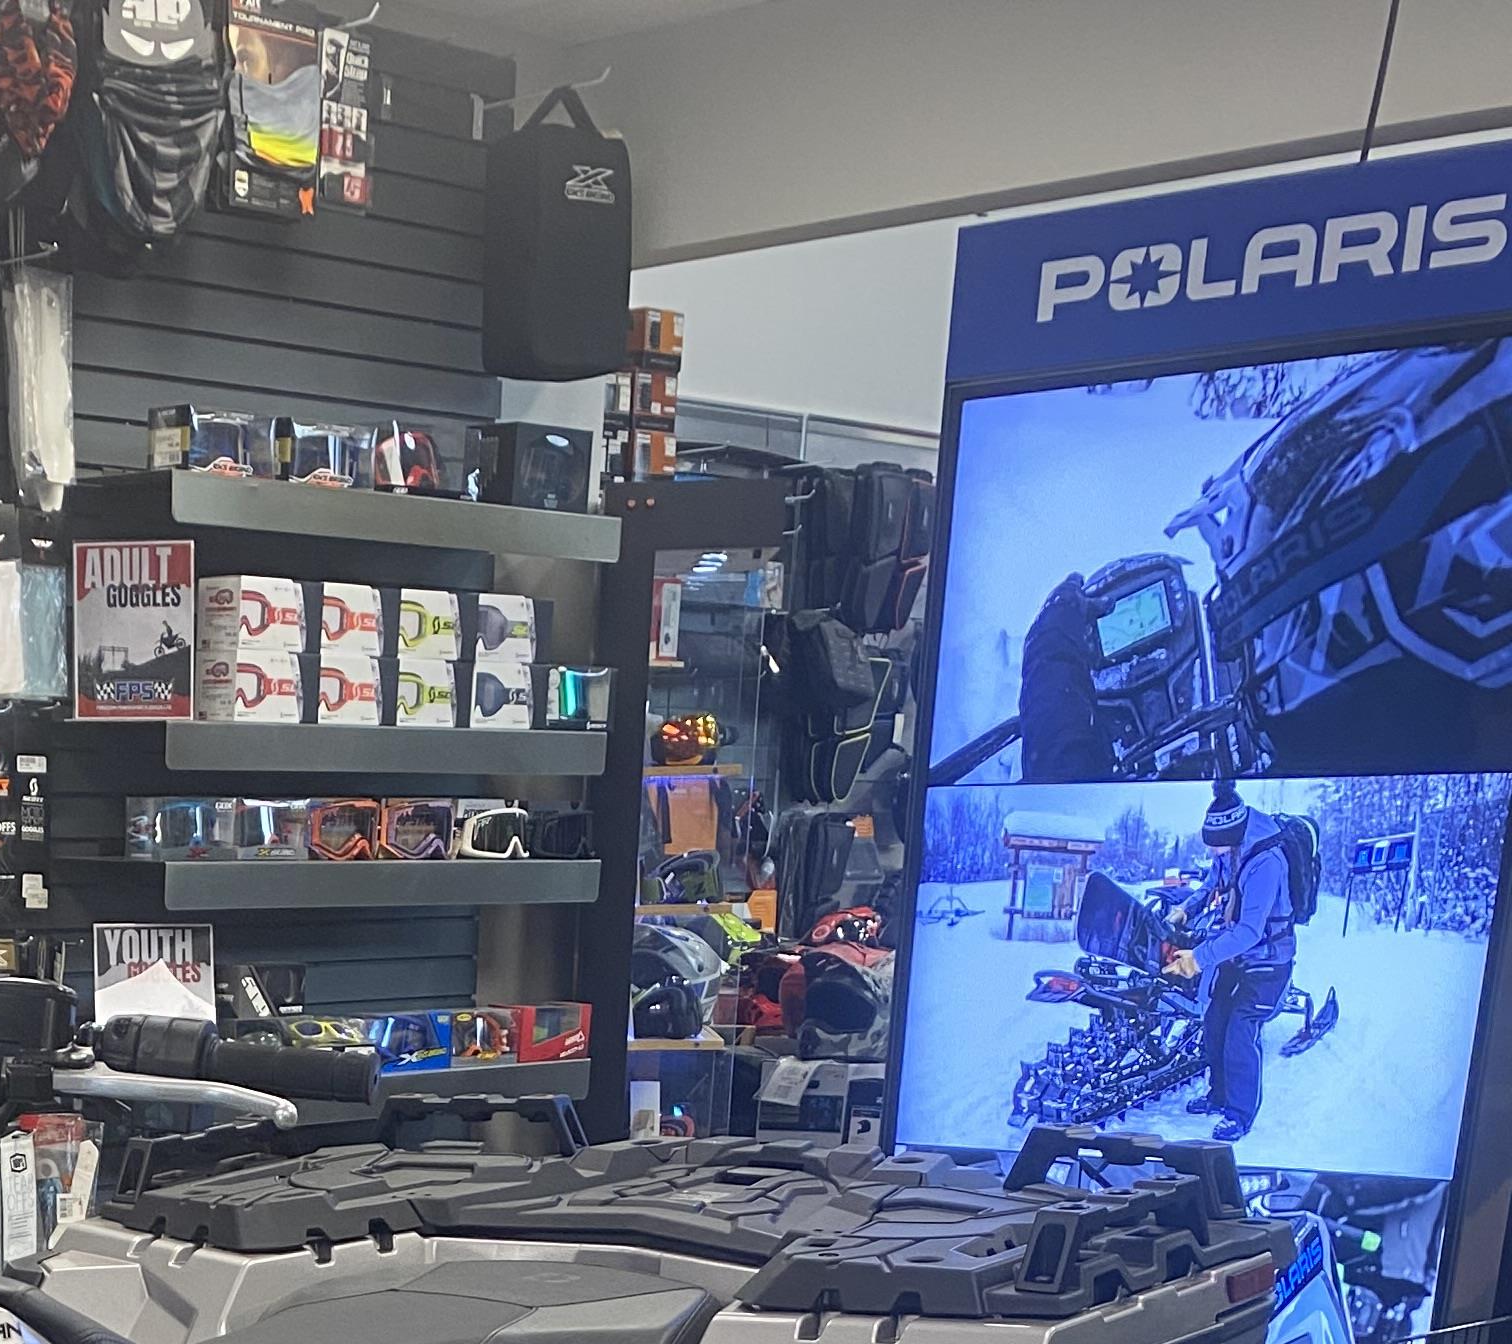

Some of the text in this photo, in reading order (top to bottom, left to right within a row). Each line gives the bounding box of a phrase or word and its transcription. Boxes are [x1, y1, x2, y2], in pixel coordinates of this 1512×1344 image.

[1036, 193, 1508, 323] POLARIS
[84, 546, 172, 589] ADULT
[106, 584, 182, 608] GOGGLES
[116, 681, 154, 702] FPS
[104, 928, 192, 965] YOUTH
